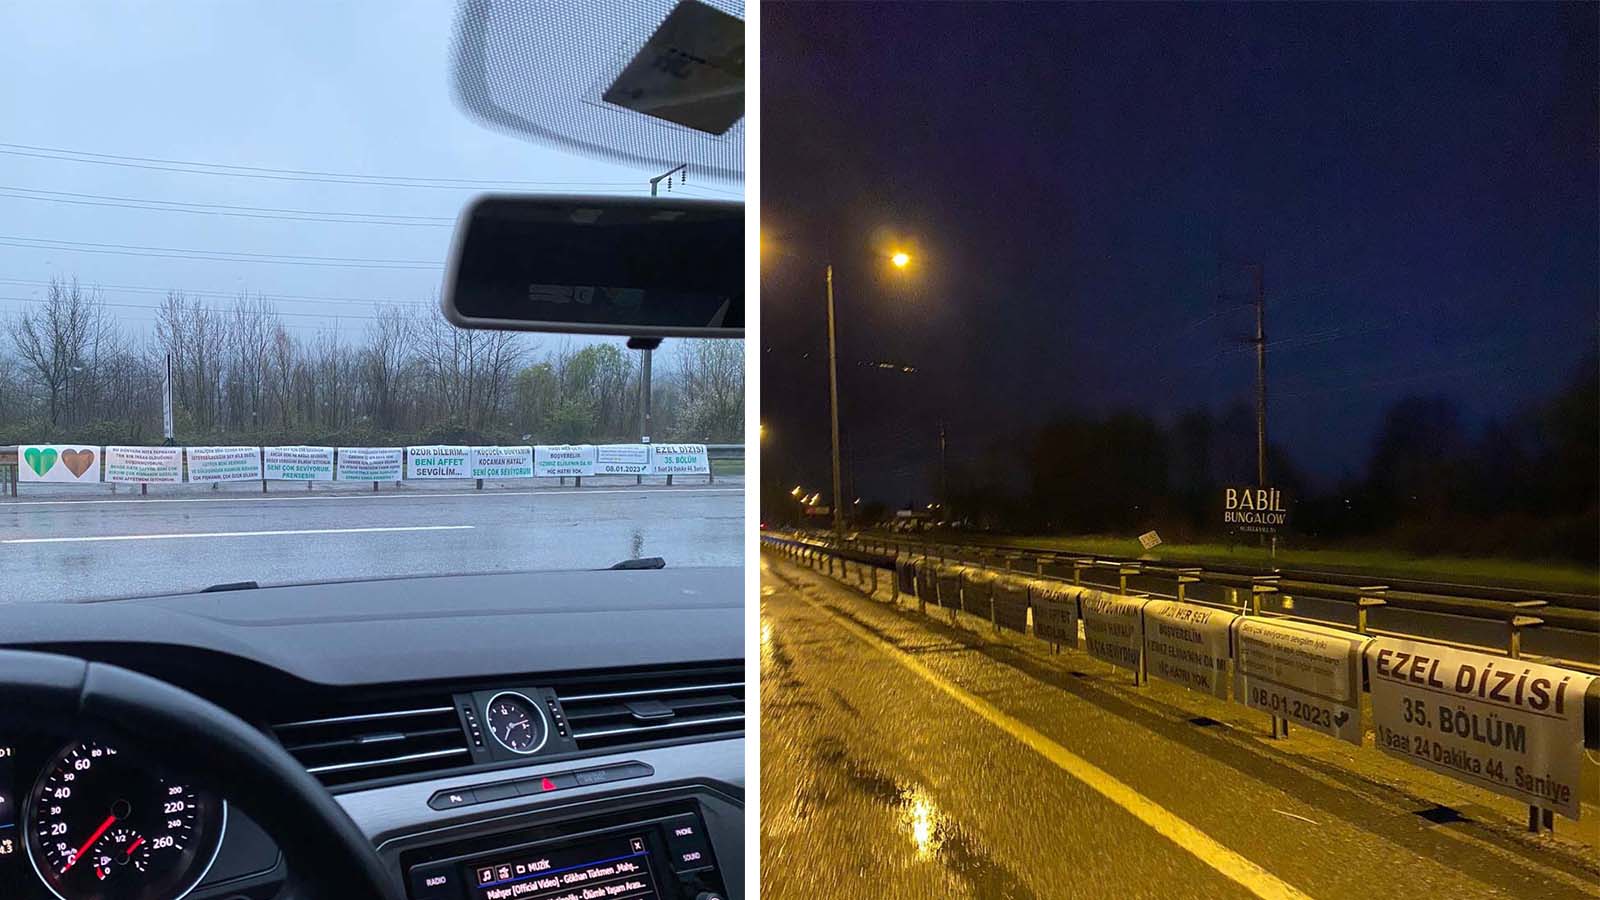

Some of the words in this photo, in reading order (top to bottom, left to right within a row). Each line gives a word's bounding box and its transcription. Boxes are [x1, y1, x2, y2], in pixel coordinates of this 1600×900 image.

[410, 447, 431, 456] ÖZÜR
[655, 446, 678, 454] EZEL
[415, 457, 435, 466] BENİ
[438, 458, 464, 466] AFFET
[605, 465, 641, 473] 08.01.2023
[1225, 487, 1286, 512] BABİL
[1224, 511, 1286, 525] BUNGALOW
[1376, 649, 1444, 689] EZEL
[1454, 662, 1571, 715] DİZİSİ
[1252, 687, 1331, 728] 08.01.2023
[1402, 696, 1432, 729] 35.
[1438, 706, 1527, 755] BÖLÜM
[74, 758, 91, 771] 60
[1385, 727, 1411, 753] Saat
[1414, 734, 1431, 758] 24
[1432, 742, 1481, 774] Dakika
[1514, 765, 1571, 804] Saniye
[64, 773, 75, 782] 50
[54, 787, 71, 799] 40
[50, 806, 61, 815] 30
[164, 801, 184, 814] 220
[51, 823, 67, 836] 20
[167, 819, 182, 829] 240
[56, 842, 67, 851] 10
[152, 836, 174, 850] 260
[682, 852, 701, 862] SOUND
[104, 867, 111, 875] 0
[563, 872, 588, 884] Gökhan
[586, 866, 615, 879] Türkmen
[426, 875, 447, 887] RADIO
